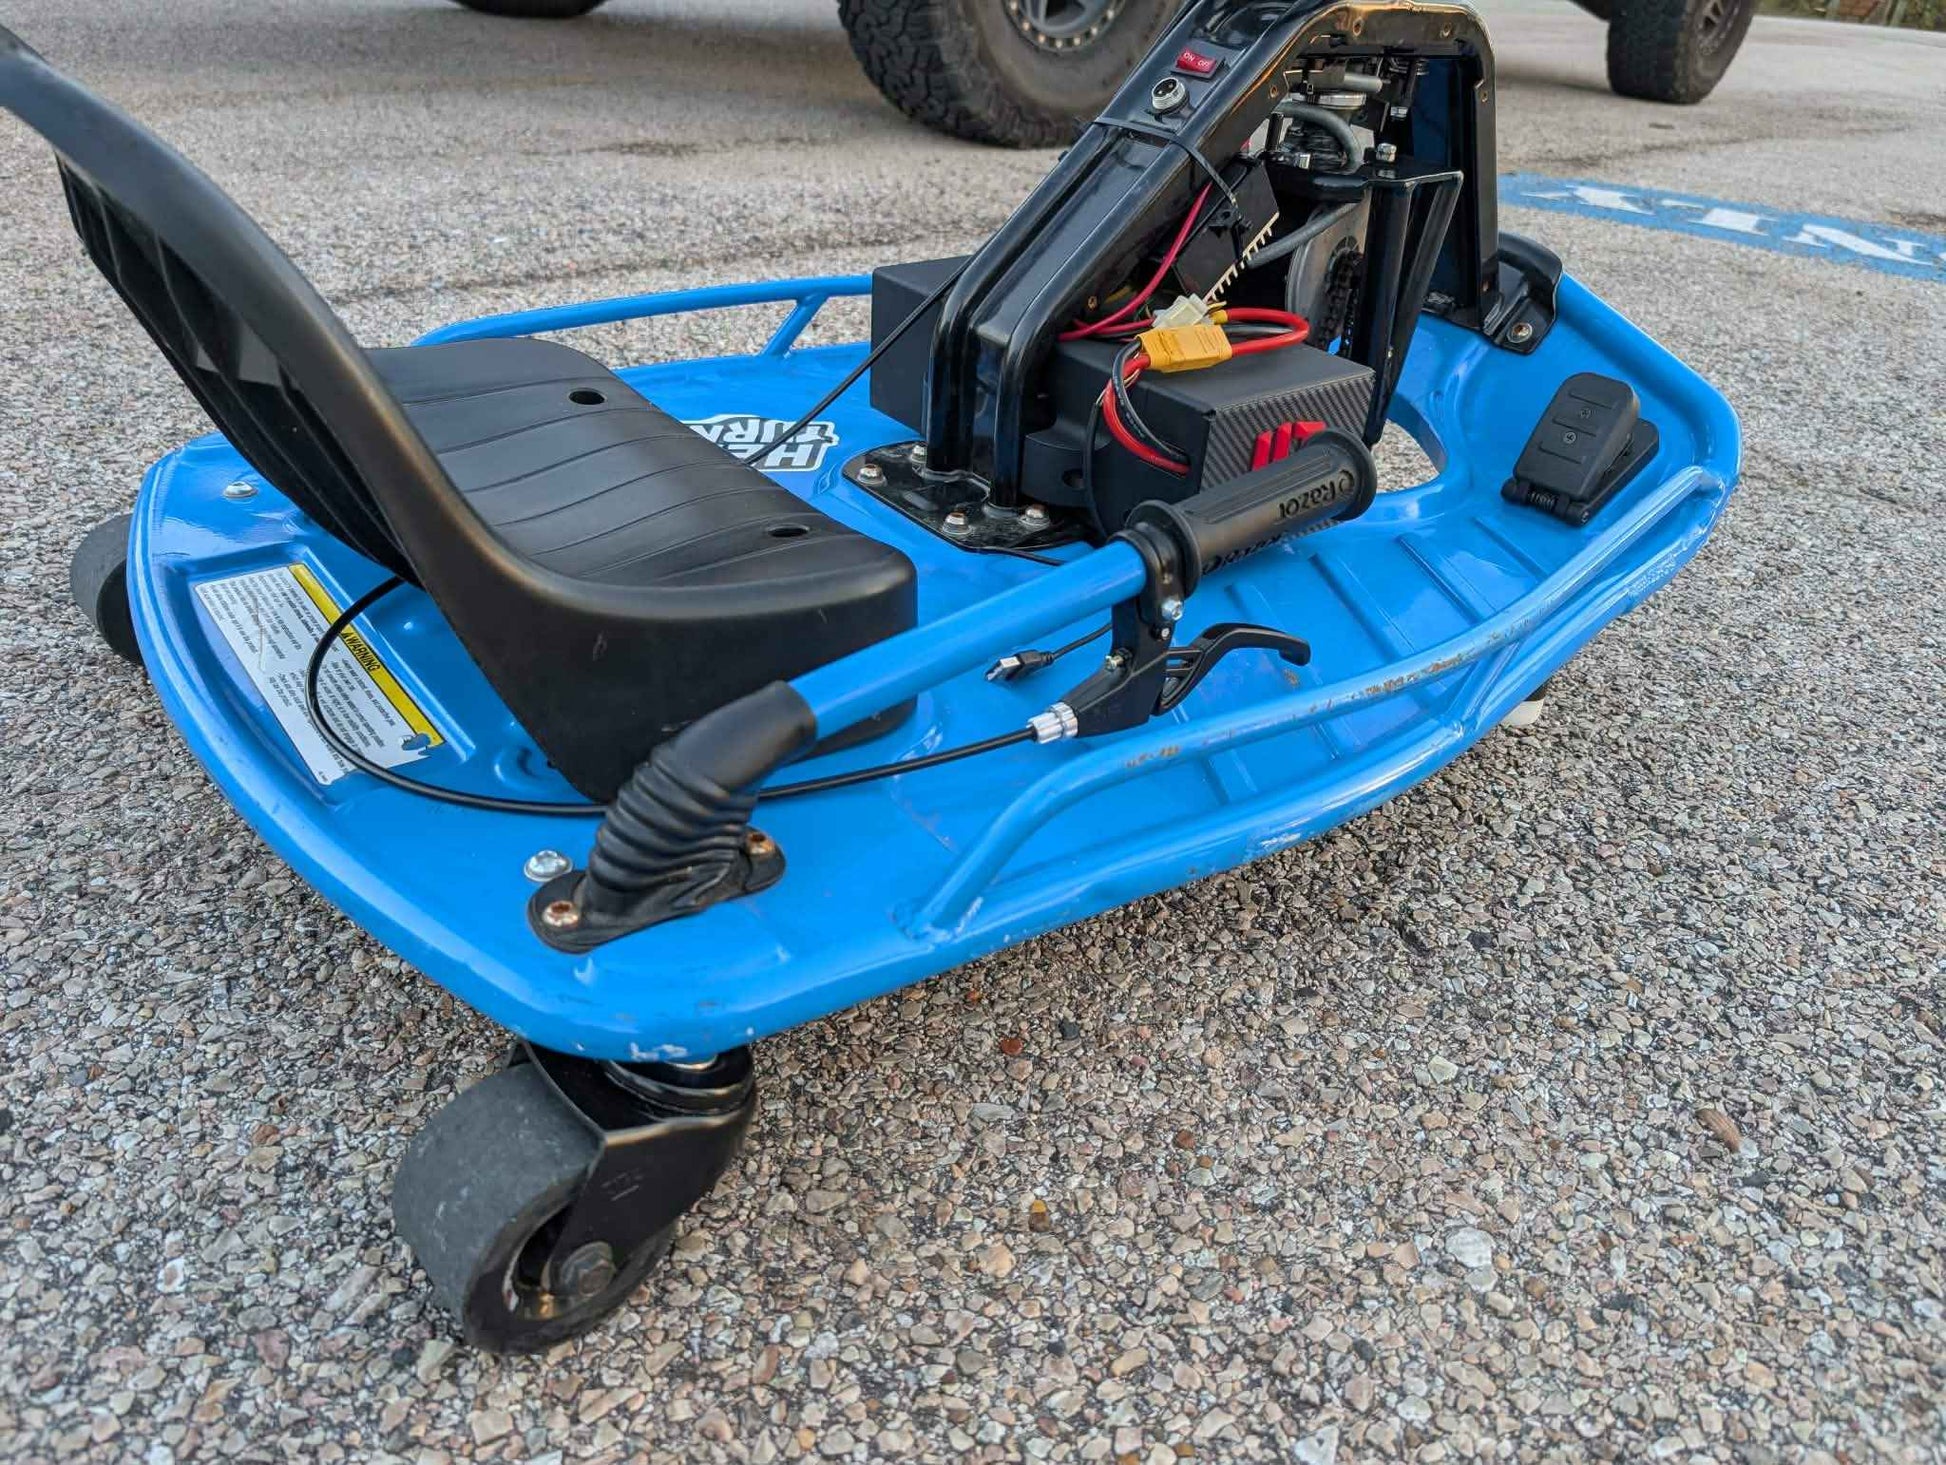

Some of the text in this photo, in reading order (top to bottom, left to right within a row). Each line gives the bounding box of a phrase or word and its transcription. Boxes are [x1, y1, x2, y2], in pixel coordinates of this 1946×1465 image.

[1183, 51, 1195, 62] ON
[1521, 184, 1946, 266] NLY
[1279, 481, 1336, 519] Razor
[345, 635, 380, 671] WARNING
